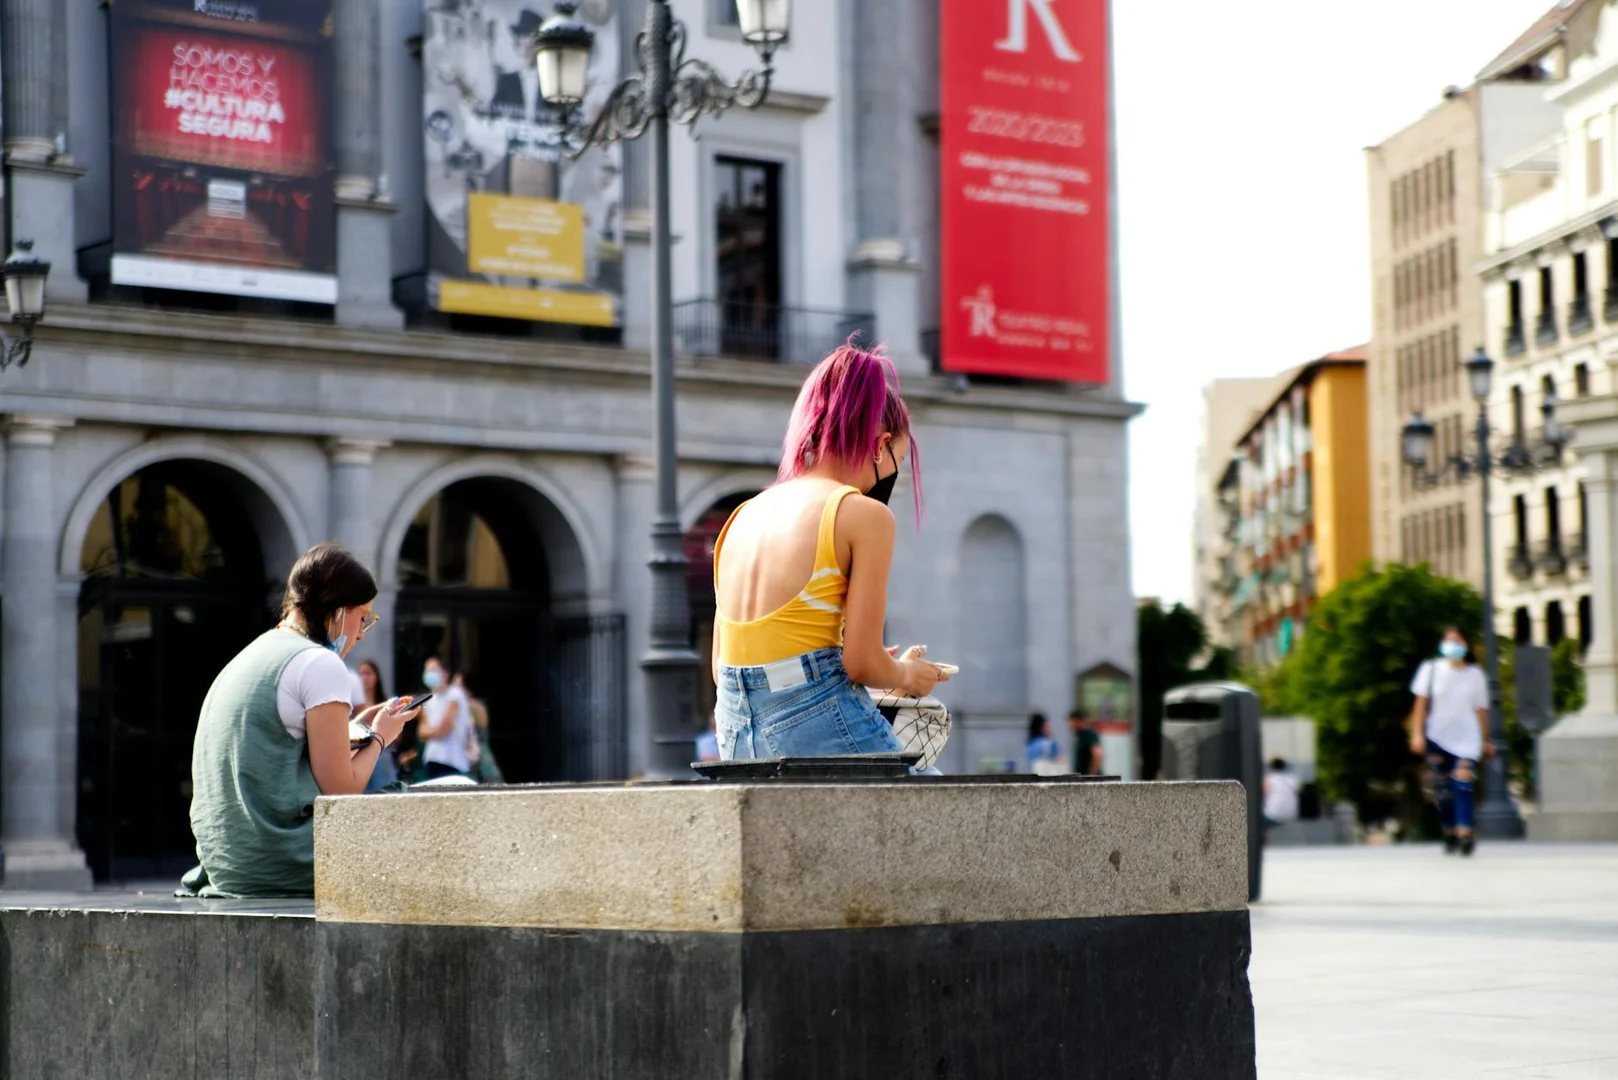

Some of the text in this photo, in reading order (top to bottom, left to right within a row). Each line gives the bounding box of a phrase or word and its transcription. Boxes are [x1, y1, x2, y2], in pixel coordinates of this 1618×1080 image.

[172, 43, 275, 78] SOMOS Y
[170, 65, 279, 101] HACEMOS
[164, 88, 285, 124] #CULTURA
[178, 112, 272, 144] SEGURA
